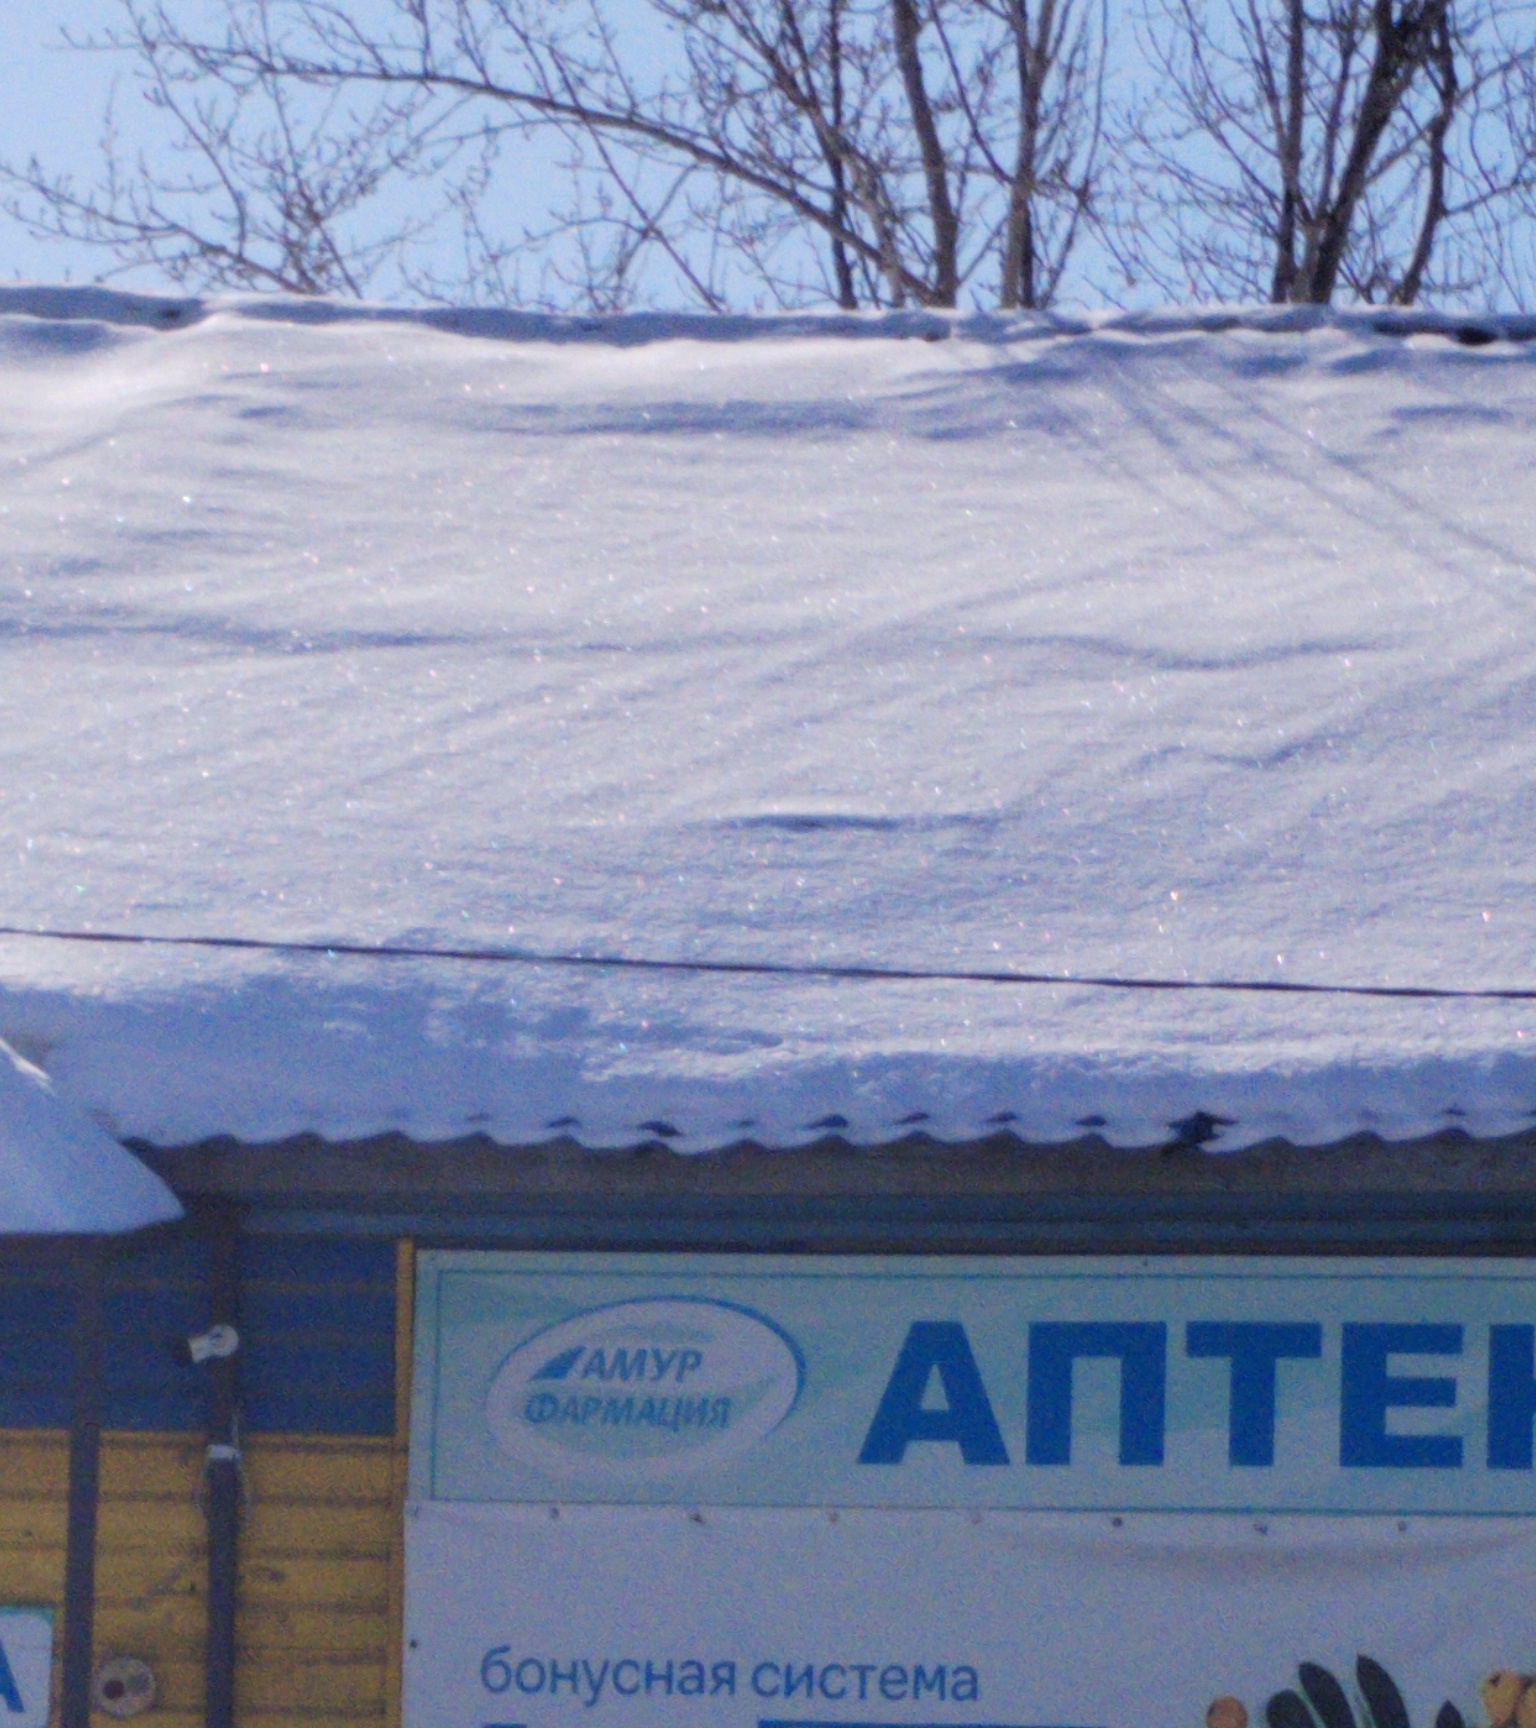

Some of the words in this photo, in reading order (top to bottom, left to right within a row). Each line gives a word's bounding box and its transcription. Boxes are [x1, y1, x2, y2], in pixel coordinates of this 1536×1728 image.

[579, 1348, 703, 1383] АМУР
[524, 1392, 732, 1432] ФАРМАЦИЯ
[479, 1644, 737, 1707] бонусная
[750, 1658, 980, 1701] система
